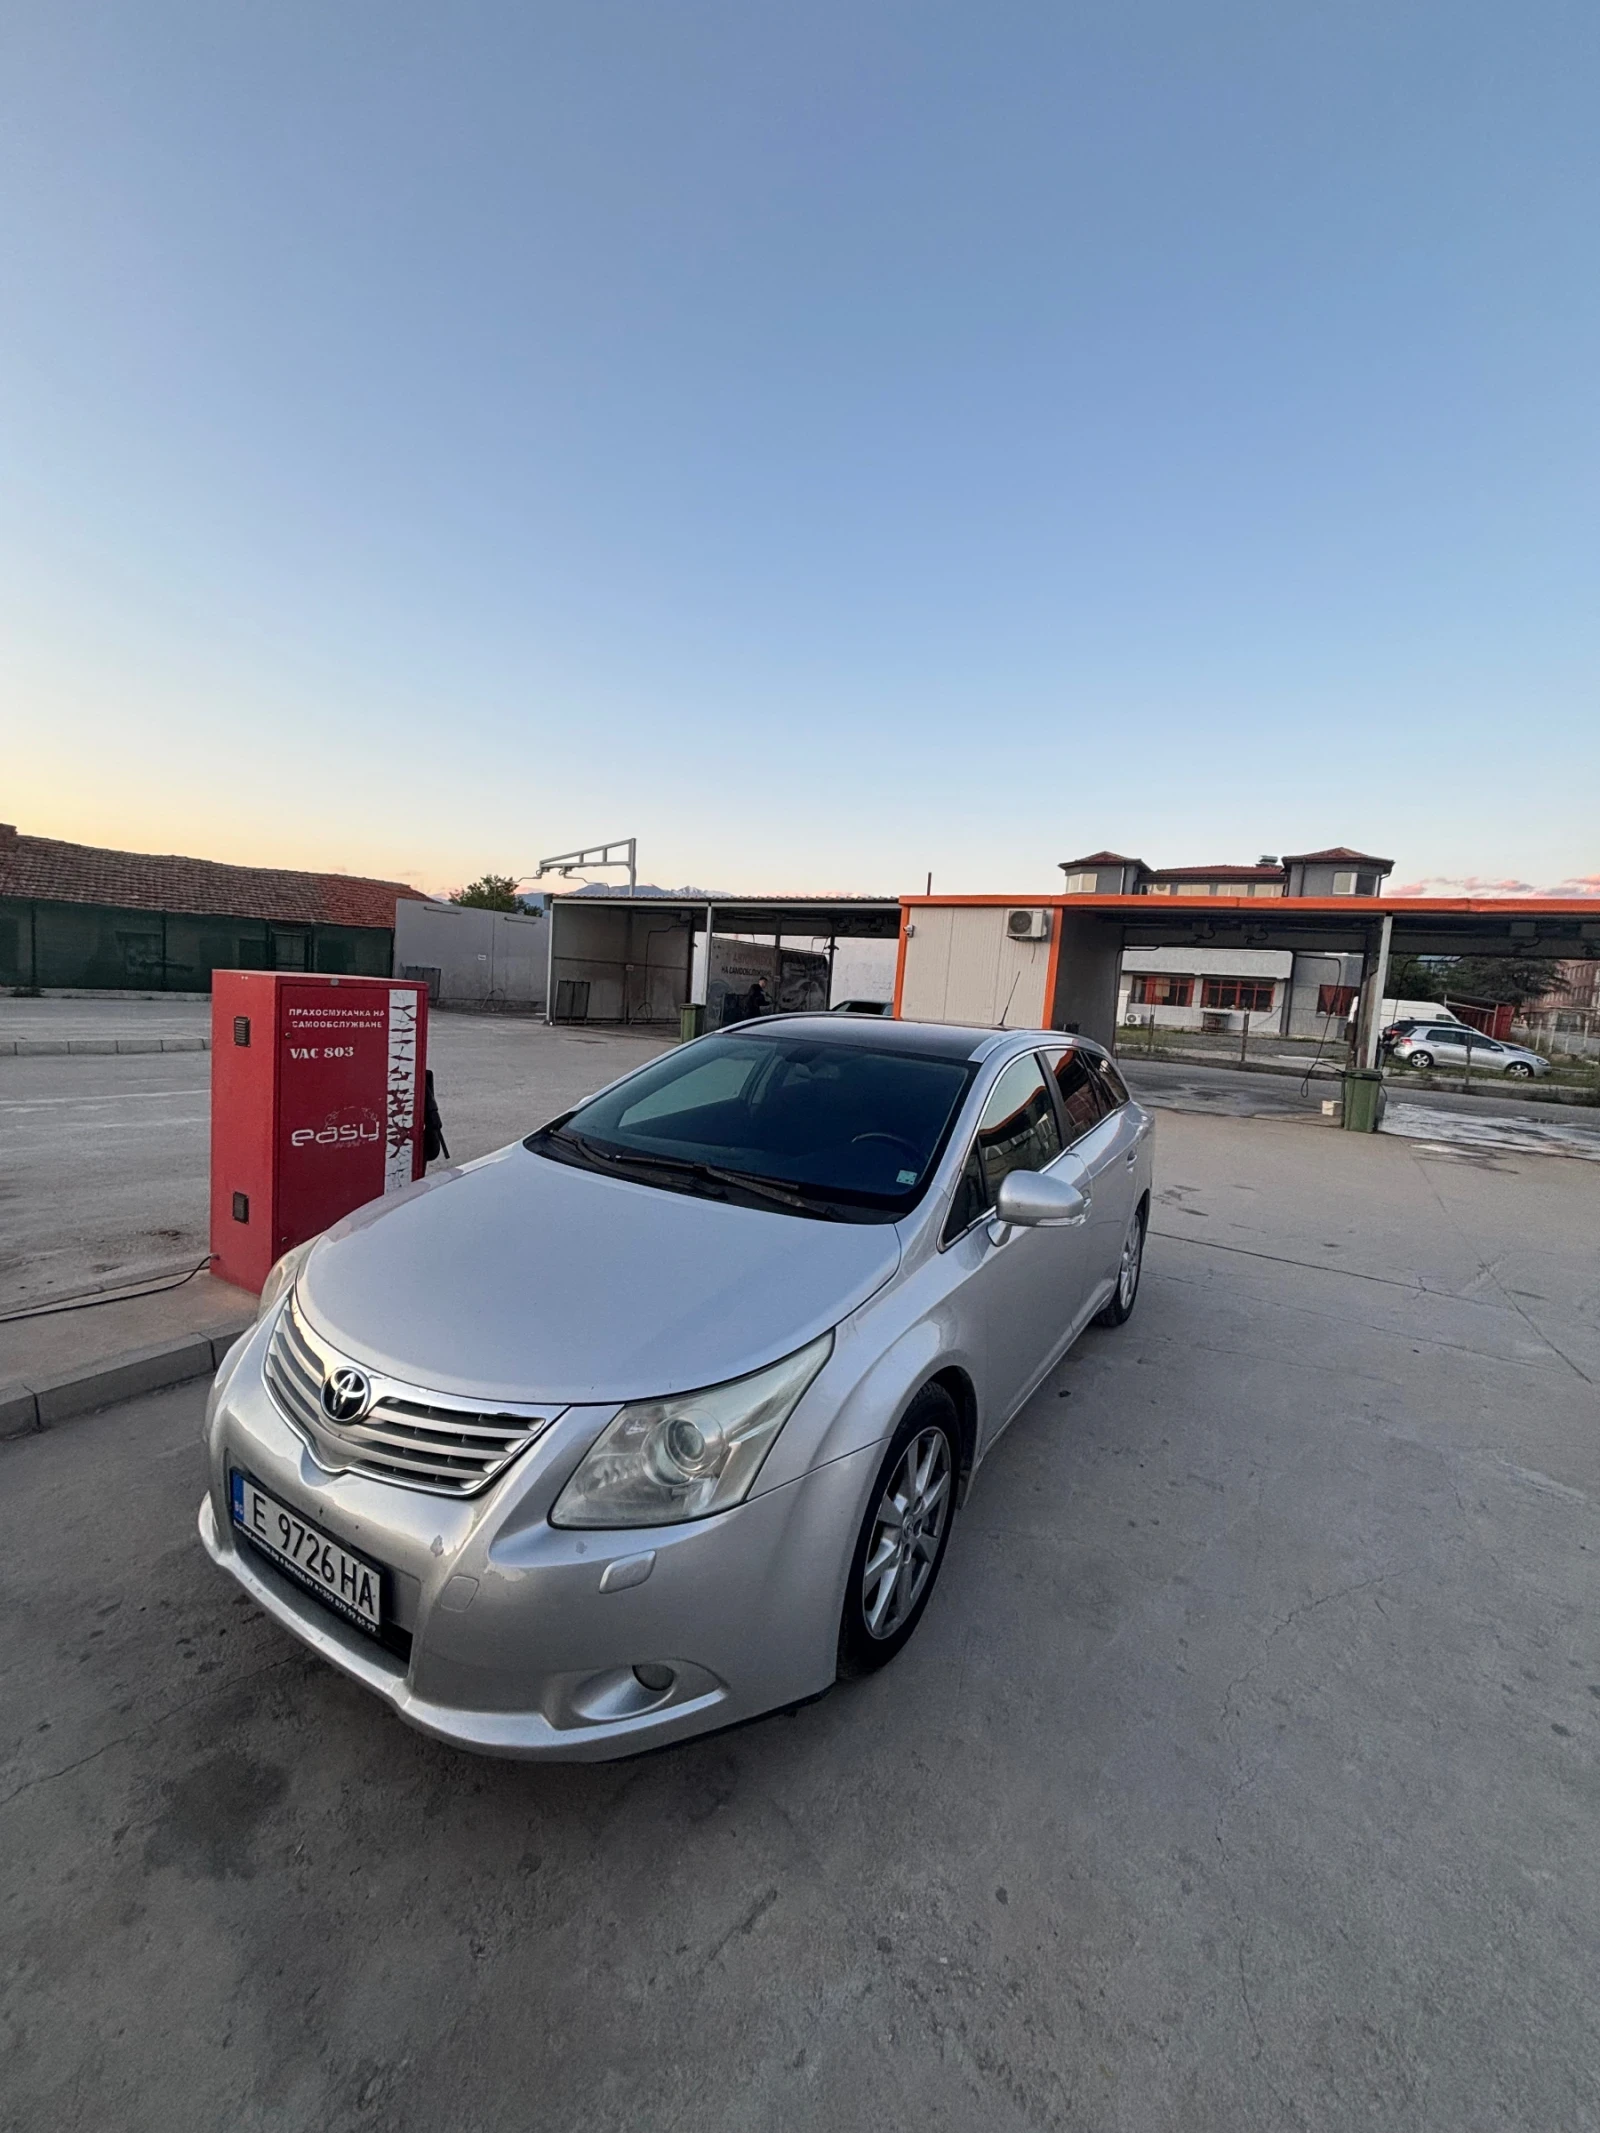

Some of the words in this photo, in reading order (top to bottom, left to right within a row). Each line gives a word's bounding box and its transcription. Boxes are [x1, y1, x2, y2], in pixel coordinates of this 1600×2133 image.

[289, 1008, 371, 1017] ПРАХОСМУКАЧКА
[373, 1009, 385, 1017] НА
[292, 1020, 382, 1028] САМООБСЛУЖВАНЕ
[290, 1047, 319, 1059] VAC
[324, 1046, 354, 1058] 803
[291, 1121, 380, 1146] easy
[253, 1491, 267, 1535] E
[278, 1512, 335, 1584] 9726
[340, 1554, 375, 1617] HA
